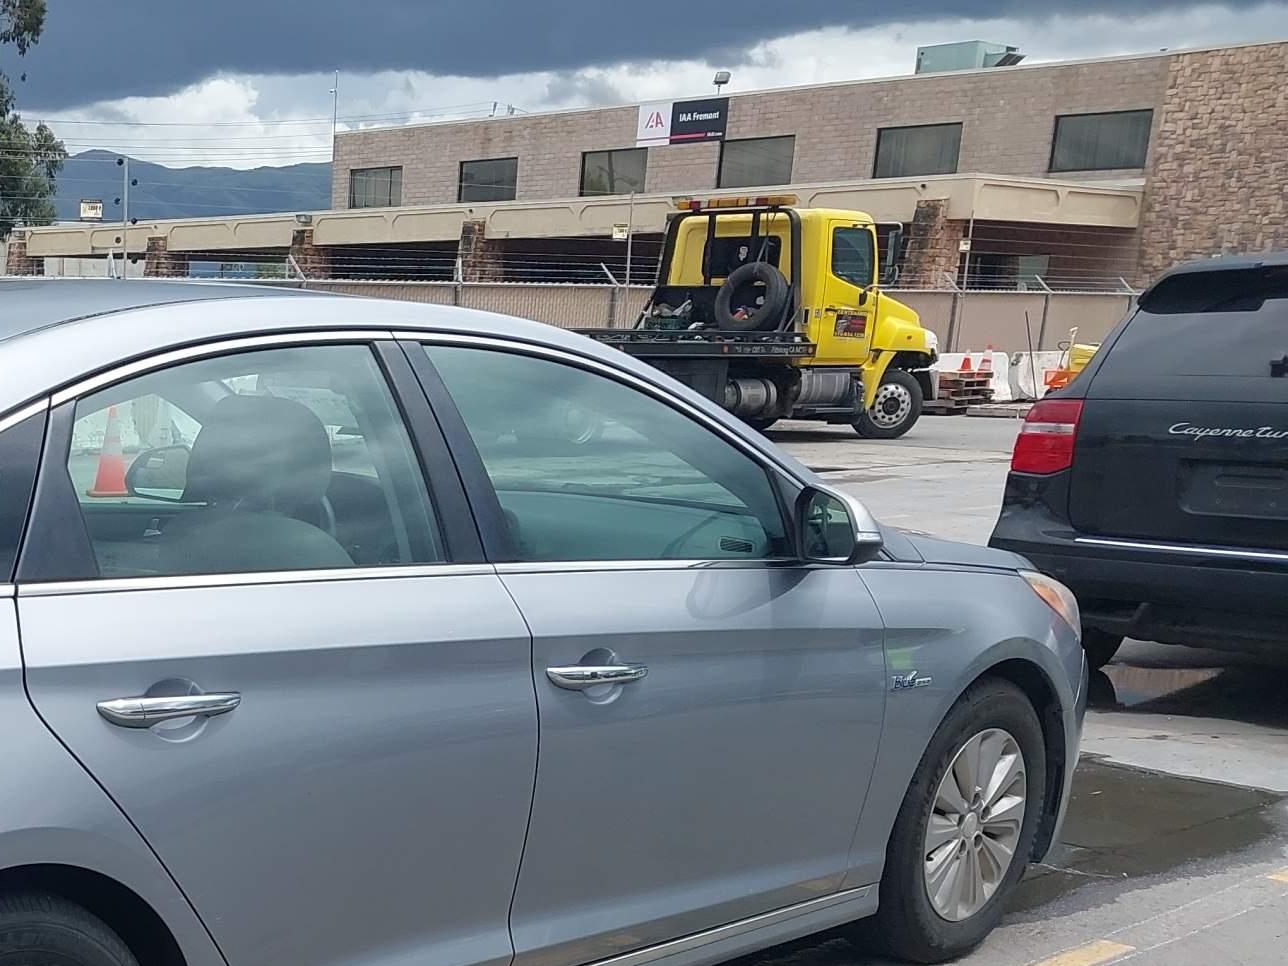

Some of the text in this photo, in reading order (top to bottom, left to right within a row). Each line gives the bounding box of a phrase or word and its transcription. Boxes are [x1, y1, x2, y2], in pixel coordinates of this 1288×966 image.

[679, 111, 720, 122] IAA Fremont
[1168, 422, 1254, 441] Cayenne
